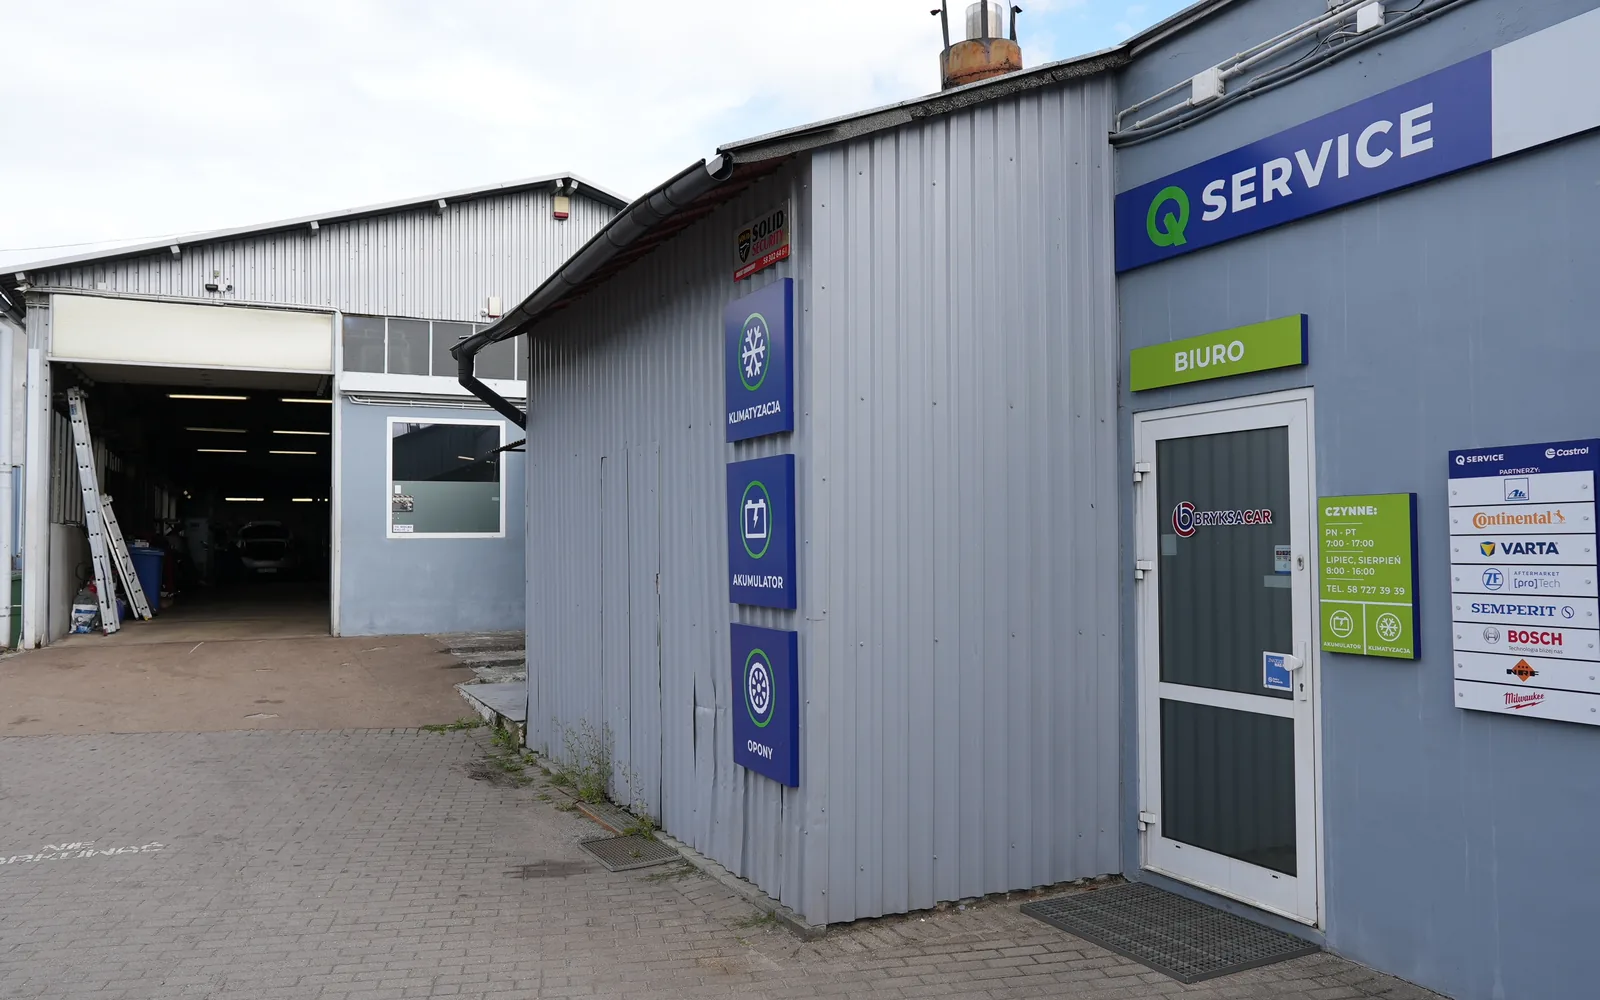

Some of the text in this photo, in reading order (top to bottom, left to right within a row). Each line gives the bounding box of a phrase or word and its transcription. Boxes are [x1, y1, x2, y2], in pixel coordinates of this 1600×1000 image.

[1146, 102, 1434, 247] Q SERVICE
[752, 210, 784, 242] SOLID
[752, 230, 784, 256] SECURITY
[1174, 340, 1244, 372] BIURO
[728, 400, 781, 424] KLIMATYZACJA
[1556, 447, 1589, 457] Castrol
[1455, 454, 1504, 465] Q SERVICE
[1499, 467, 1540, 475] PARTNERZY:
[1325, 506, 1378, 516] CZYNNE:
[1194, 510, 1272, 526] BRYKSACAR
[1472, 511, 1552, 529] Continental
[1345, 528, 1356, 536] PT
[1501, 542, 1559, 555] VARTA
[1326, 555, 1401, 565] LIPIEC, SIERPIEŃ
[1326, 567, 1344, 575] 8:00
[1352, 568, 1375, 576] 16:00
[733, 574, 783, 588] AKUMULATOR
[1485, 572, 1503, 586] ZF
[1347, 586, 1358, 594] 58
[1361, 586, 1376, 594] 727
[1380, 587, 1391, 595] 39
[1394, 587, 1405, 595] 39
[1471, 603, 1556, 616] SEMPERIT
[1508, 630, 1563, 646] BOSCH
[1368, 645, 1410, 654] KLIMATYZACJA
[1504, 692, 1545, 704] Milwaukee
[748, 740, 773, 760] OPONY
[43, 840, 95, 850] NIE
